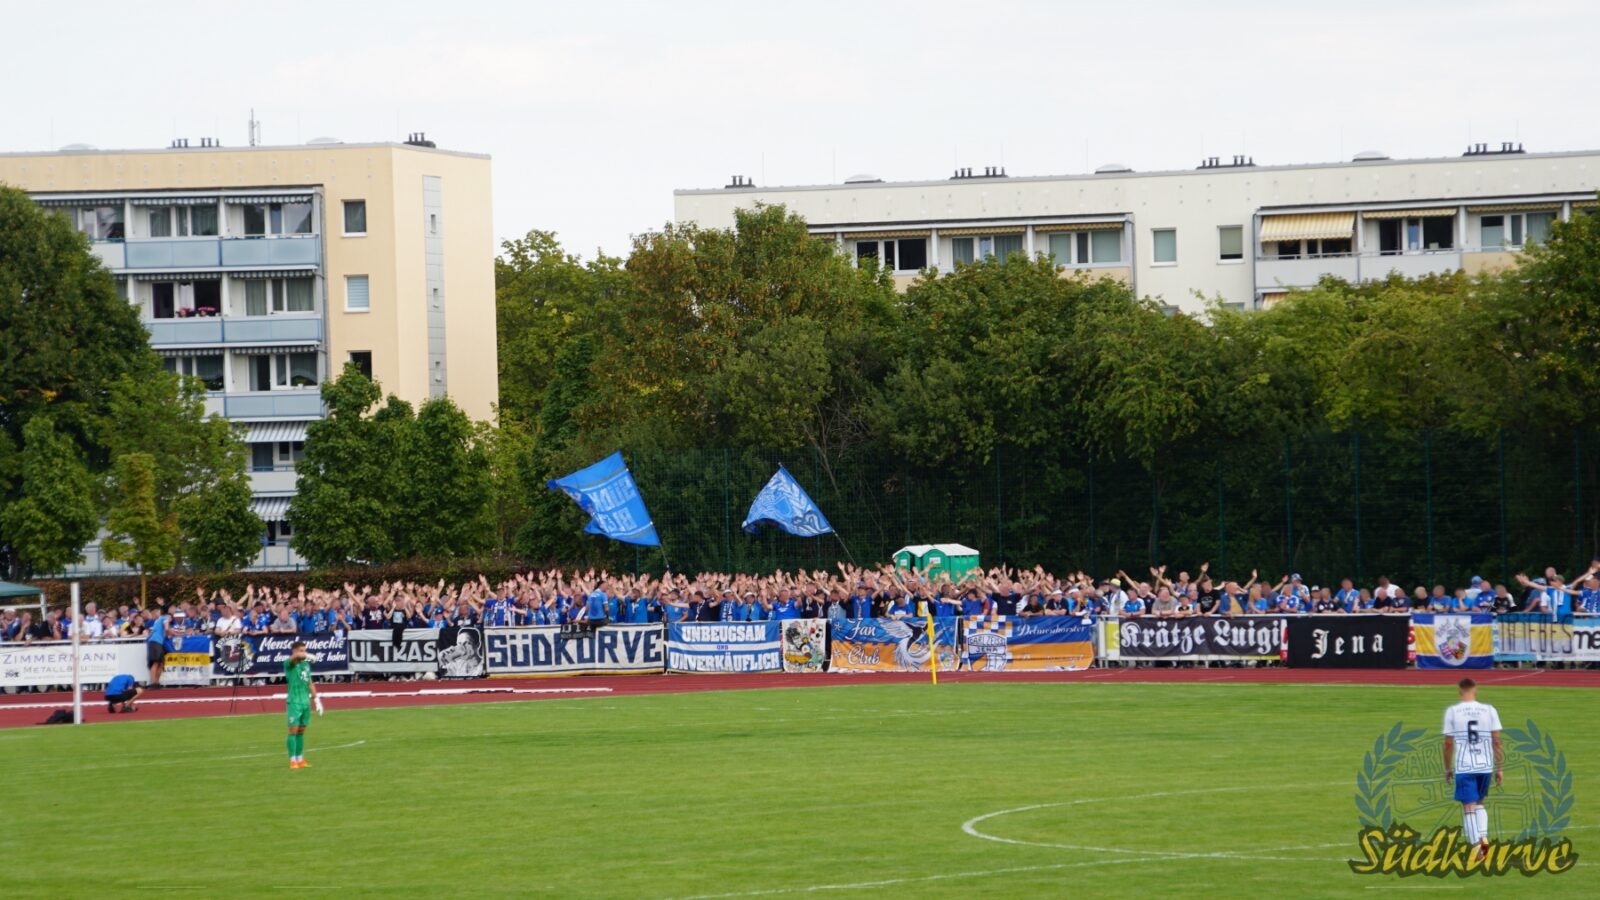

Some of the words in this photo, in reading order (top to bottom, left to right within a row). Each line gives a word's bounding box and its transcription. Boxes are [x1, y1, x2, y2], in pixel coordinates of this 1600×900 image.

[681, 625, 766, 642] UNBEUGSAM
[1120, 621, 1206, 654] Krätze
[1213, 619, 1281, 655] Luigi
[1311, 628, 1384, 660] Jena
[3, 652, 117, 665] ZIMMERANN
[350, 641, 437, 662] ULTRAS
[486, 629, 663, 668] SÜDKURVE
[23, 665, 88, 674] METALLBU
[669, 651, 780, 672] UNVERKÄUFLICH
[1467, 720, 1479, 744] 6
